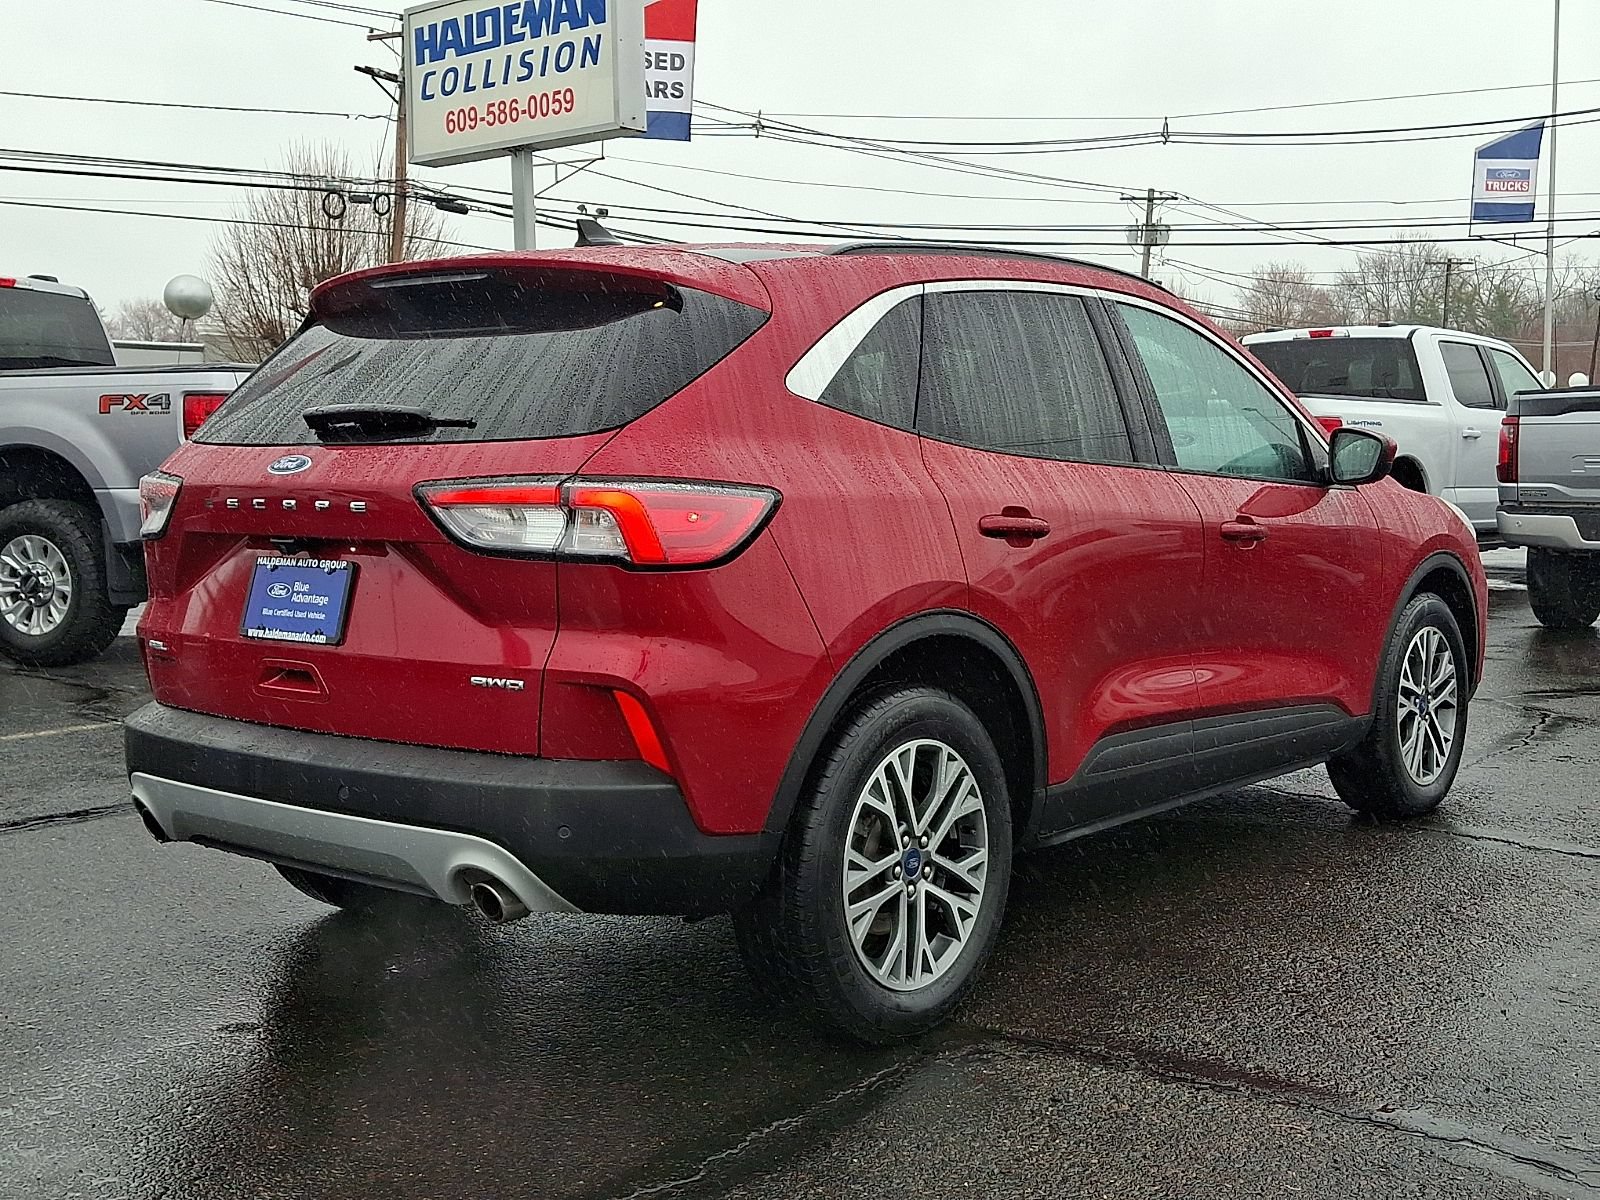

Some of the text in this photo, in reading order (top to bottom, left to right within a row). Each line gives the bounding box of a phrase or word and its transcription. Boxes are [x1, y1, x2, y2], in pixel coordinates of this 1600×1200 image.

[415, 0, 606, 66] HALDEMAN
[420, 33, 602, 100] COLLISION
[645, 51, 685, 71] SED
[445, 87, 575, 134] 609-586-0059
[1486, 181, 1529, 191] TRUCKS
[99, 393, 171, 414] FX4
[273, 456, 301, 470] Ford
[205, 498, 366, 513] ESCAPE
[257, 556, 347, 569] HALDEMAN AUTO GROUP
[271, 584, 288, 595] Ford
[293, 581, 310, 592] Blue
[291, 592, 329, 606] Advantage
[262, 608, 326, 620] Blue Certified Used Vehicle
[247, 628, 327, 643] www.haldemanauto.com
